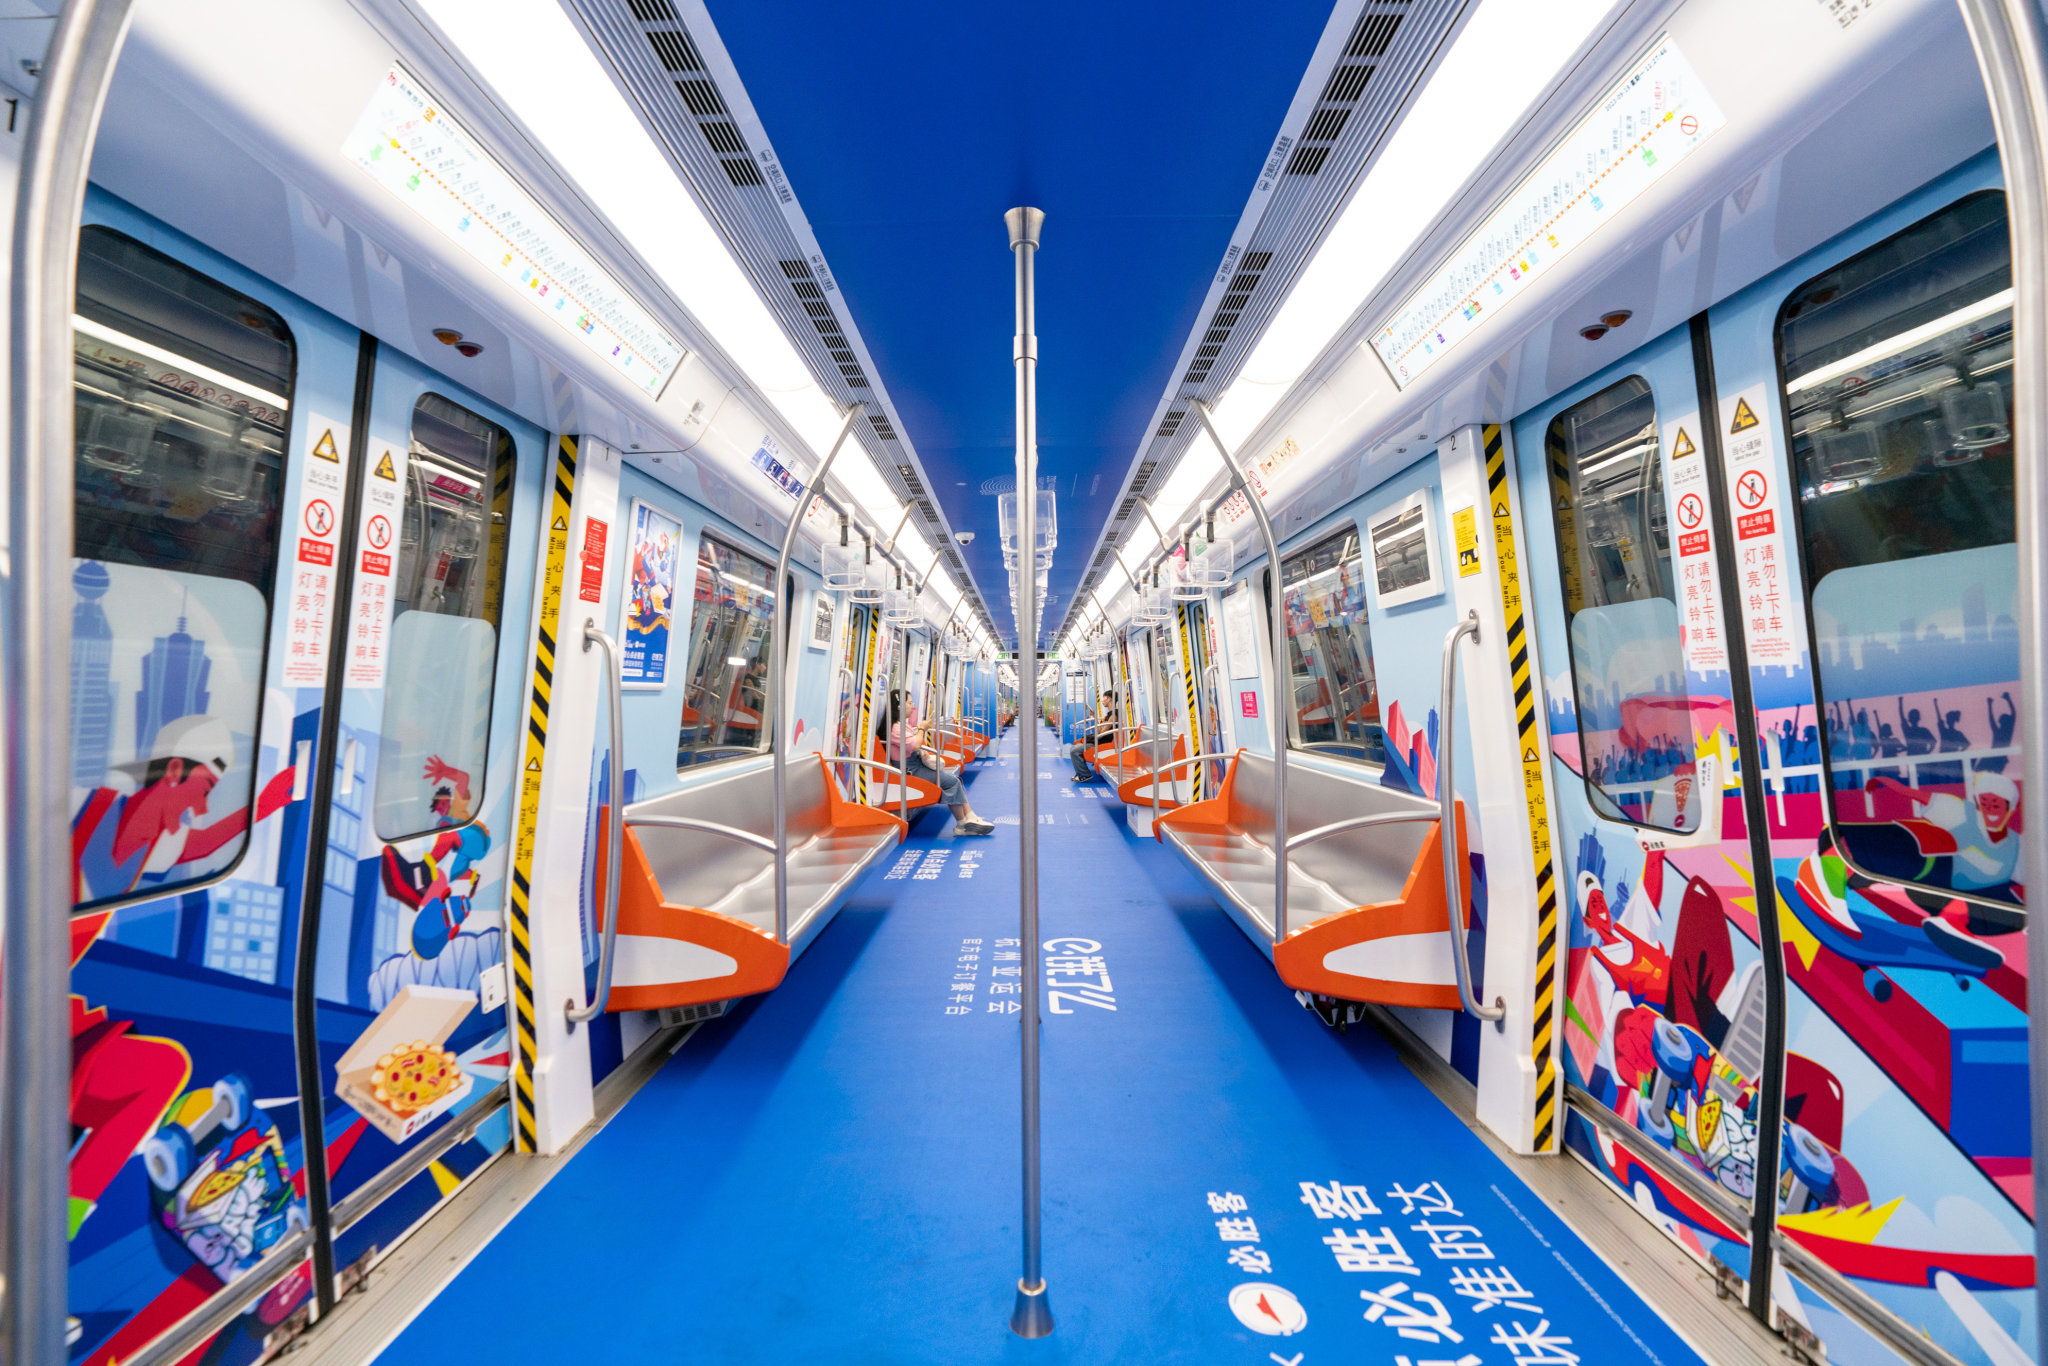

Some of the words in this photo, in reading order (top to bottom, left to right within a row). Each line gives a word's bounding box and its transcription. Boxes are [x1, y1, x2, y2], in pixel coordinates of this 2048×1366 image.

[4, 98, 18, 133] 1
[1451, 435, 1457, 452] 2
[547, 538, 566, 618] 当心夹手
[1502, 525, 1521, 606] 当心夹手
[1684, 564, 1703, 642] 灯亮铃响
[1698, 562, 1717, 641] 请勿上下车
[1744, 548, 1766, 634] 灯亮铃响
[1761, 544, 1783, 632] 请勿上下车
[291, 571, 312, 657] 灯亮铃响
[308, 574, 328, 657] 请勿上下车
[355, 581, 373, 659] 灯亮铃响
[368, 584, 386, 660] 请勿上下车
[521, 780, 540, 860] 当心夹手
[1532, 771, 1550, 851] 当心夹手
[945, 938, 982, 1016] 官方电子订餐平台
[986, 938, 1022, 1014] 杭州亚运会
[1207, 1190, 1273, 1274] 必胜客
